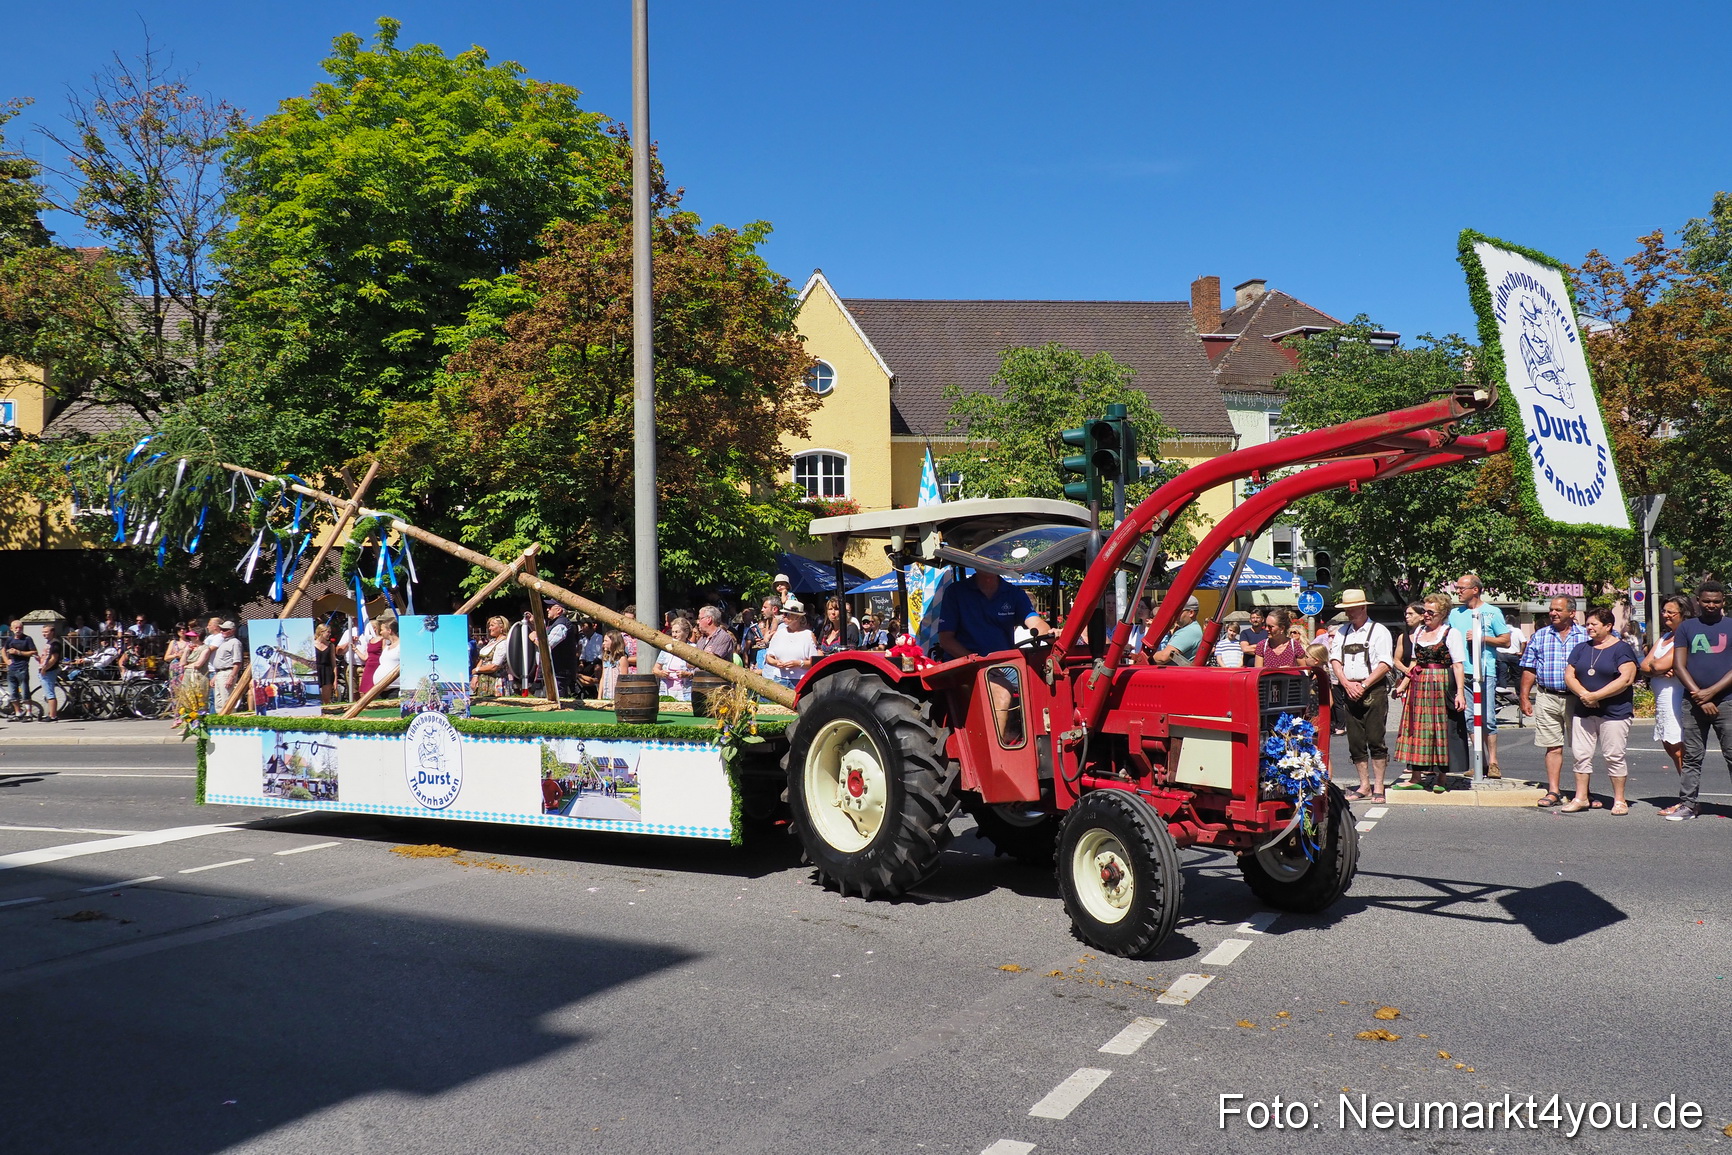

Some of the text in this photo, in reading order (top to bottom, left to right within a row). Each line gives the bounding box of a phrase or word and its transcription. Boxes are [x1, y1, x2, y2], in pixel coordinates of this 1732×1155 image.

[1495, 270, 1576, 343] Frühschoppenverein
[1533, 404, 1591, 446] Durst
[1527, 429, 1606, 507] Thannhausen
[410, 776, 459, 806] Thannhausen
[418, 771, 451, 785] Durst
